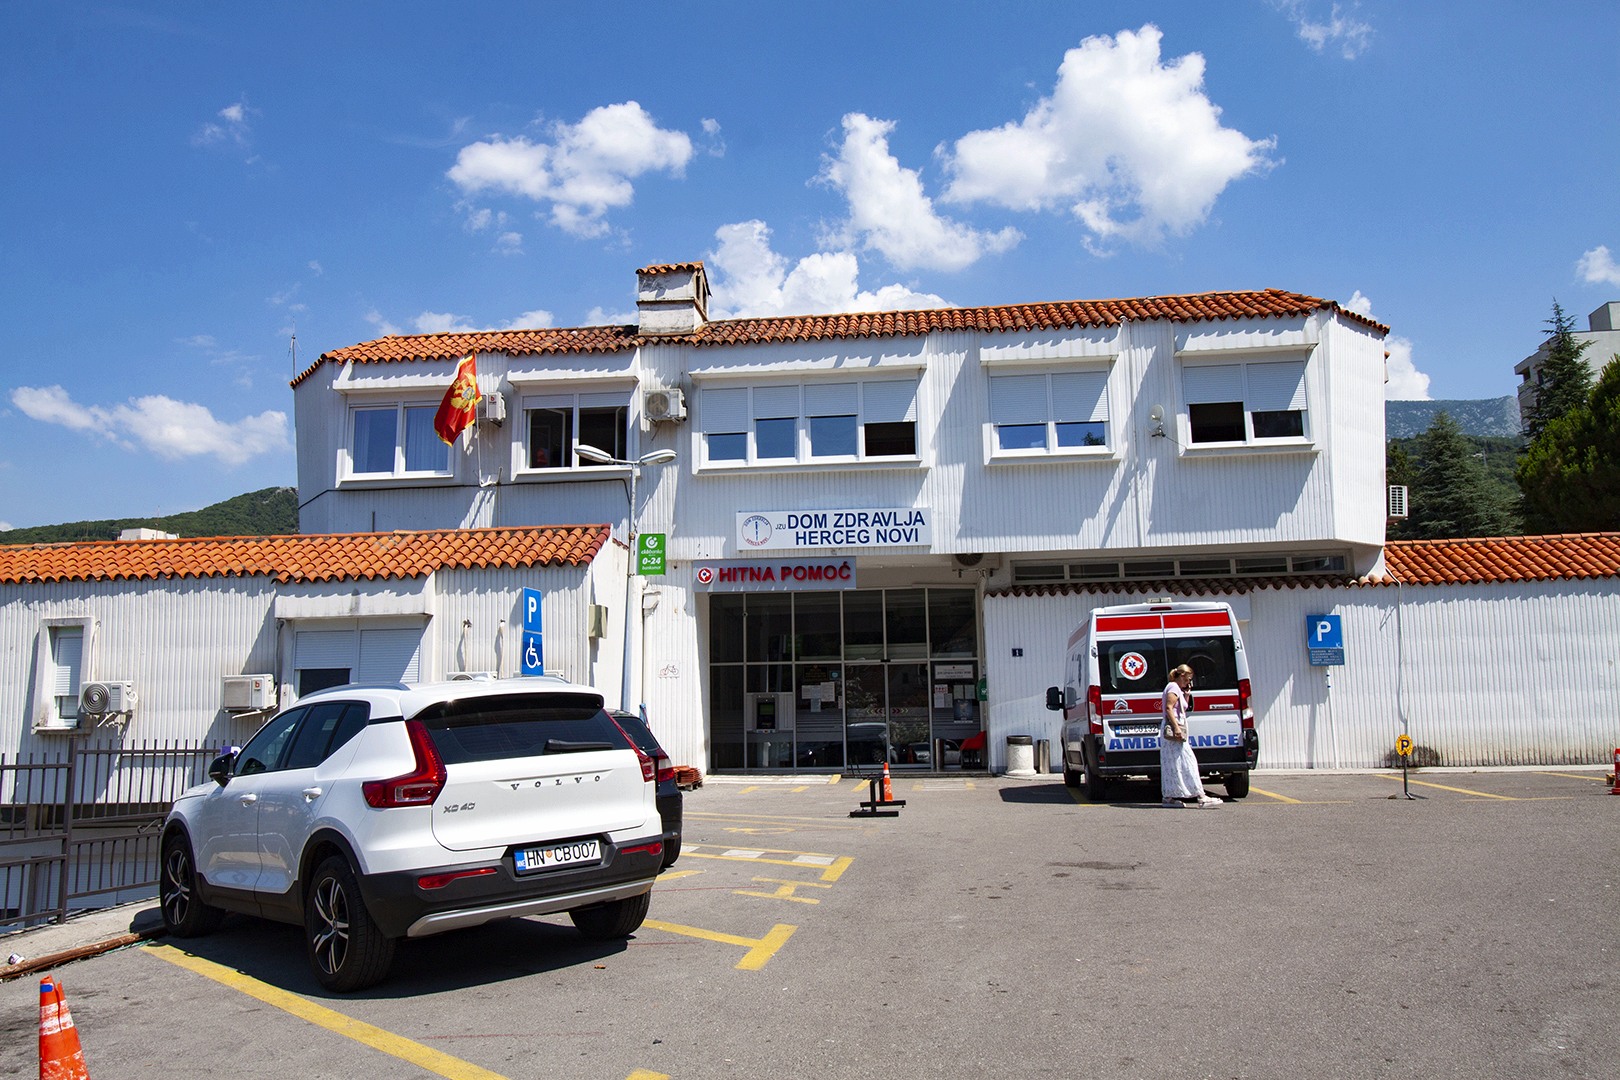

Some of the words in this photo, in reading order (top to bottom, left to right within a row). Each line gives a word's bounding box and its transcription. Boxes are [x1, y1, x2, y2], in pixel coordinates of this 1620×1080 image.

[787, 514, 827, 530] DOM
[833, 511, 926, 528] ZDRAVLJA
[795, 529, 870, 546] HERCEG
[876, 528, 919, 543] NOVI
[642, 557, 661, 565] 0-24
[719, 566, 776, 583] HITNA
[780, 561, 851, 582] POMOĆ
[528, 596, 537, 623] P
[1316, 621, 1332, 642] P
[1401, 739, 1410, 751] P
[511, 775, 600, 790] VOLVO
[526, 849, 546, 867] HN
[553, 842, 597, 862] CB007
